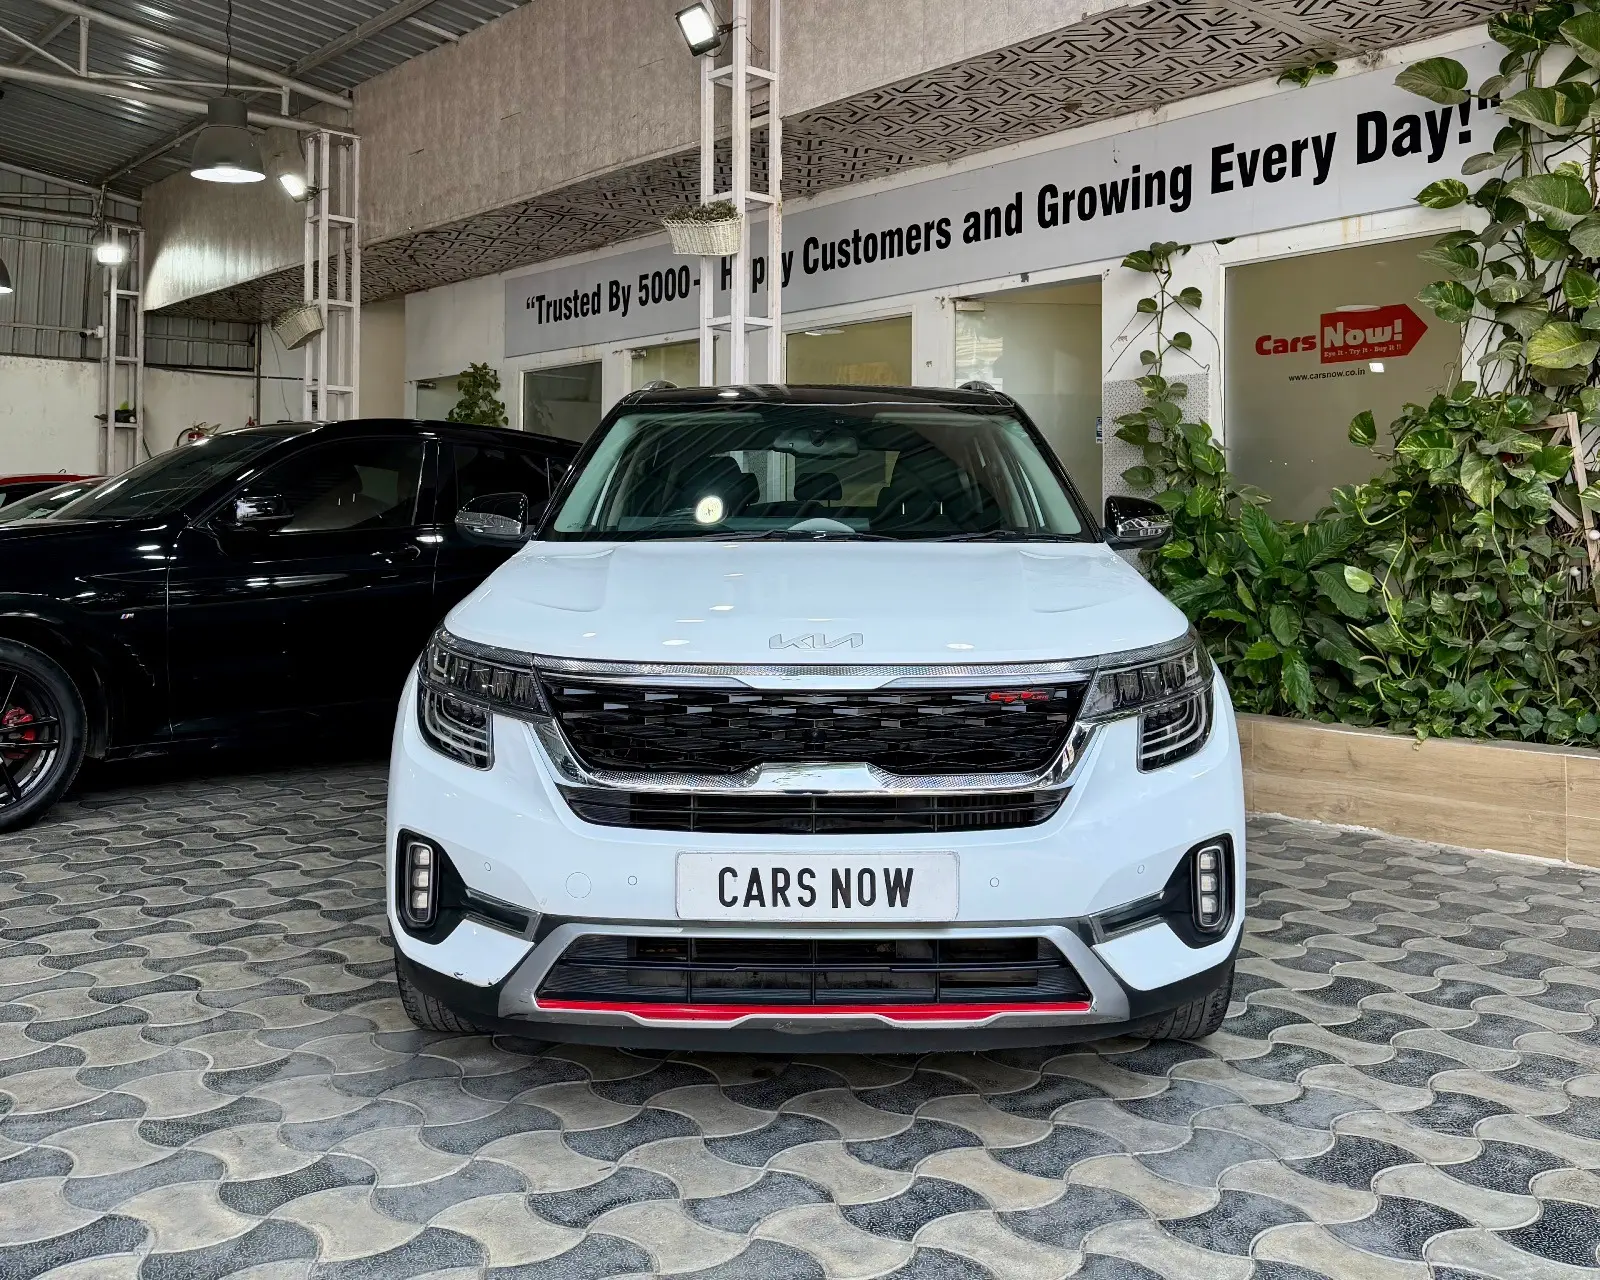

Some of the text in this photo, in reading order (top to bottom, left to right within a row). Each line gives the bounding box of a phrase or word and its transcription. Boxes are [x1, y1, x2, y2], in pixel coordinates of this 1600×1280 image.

[608, 280, 631, 317] By
[721, 250, 793, 293] Hpy
[803, 217, 951, 275] Customers
[962, 191, 1012, 244] and
[1037, 164, 1192, 229] Growing
[1210, 132, 1337, 194] Every
[1255, 319, 1403, 356] Cars Now!
[1288, 367, 1366, 382] www.carsnow.co.in
[718, 866, 914, 909] CARS NOW
